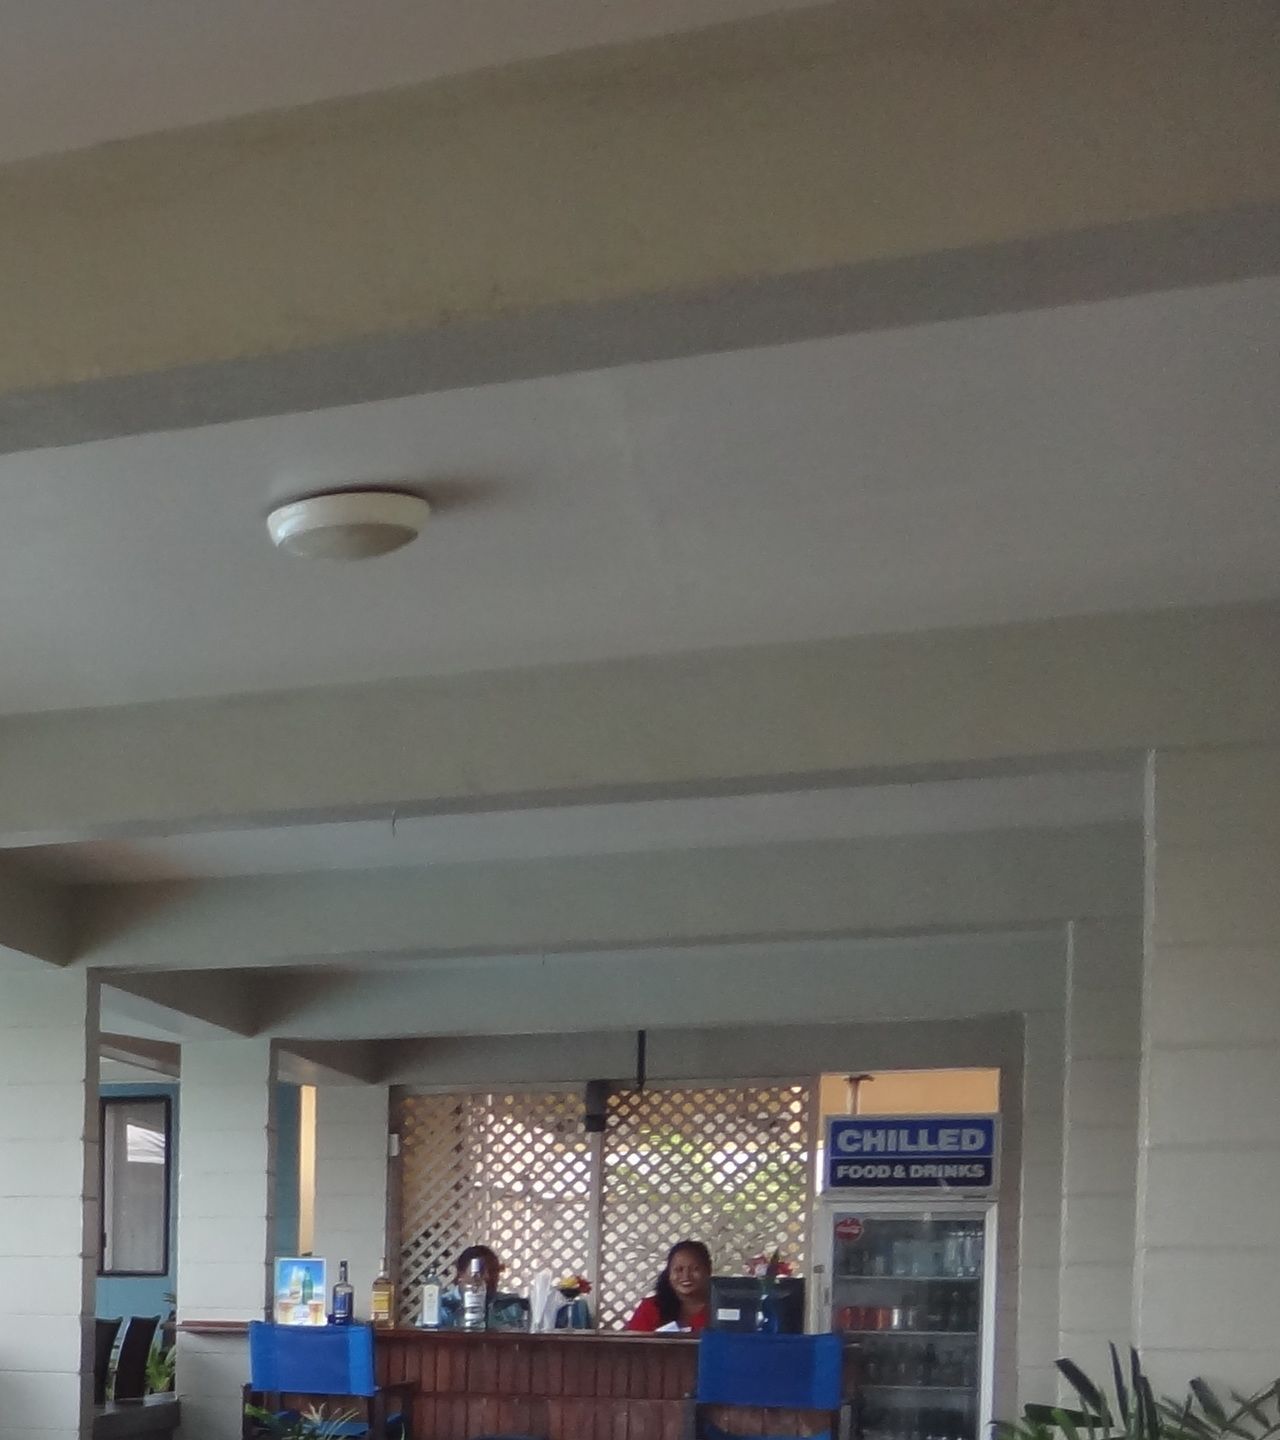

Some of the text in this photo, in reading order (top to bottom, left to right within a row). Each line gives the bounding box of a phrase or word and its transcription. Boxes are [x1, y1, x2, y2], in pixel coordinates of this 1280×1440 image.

[837, 1129, 986, 1152] CHILLED
[837, 1164, 985, 1178] FOOD & DRINKS
